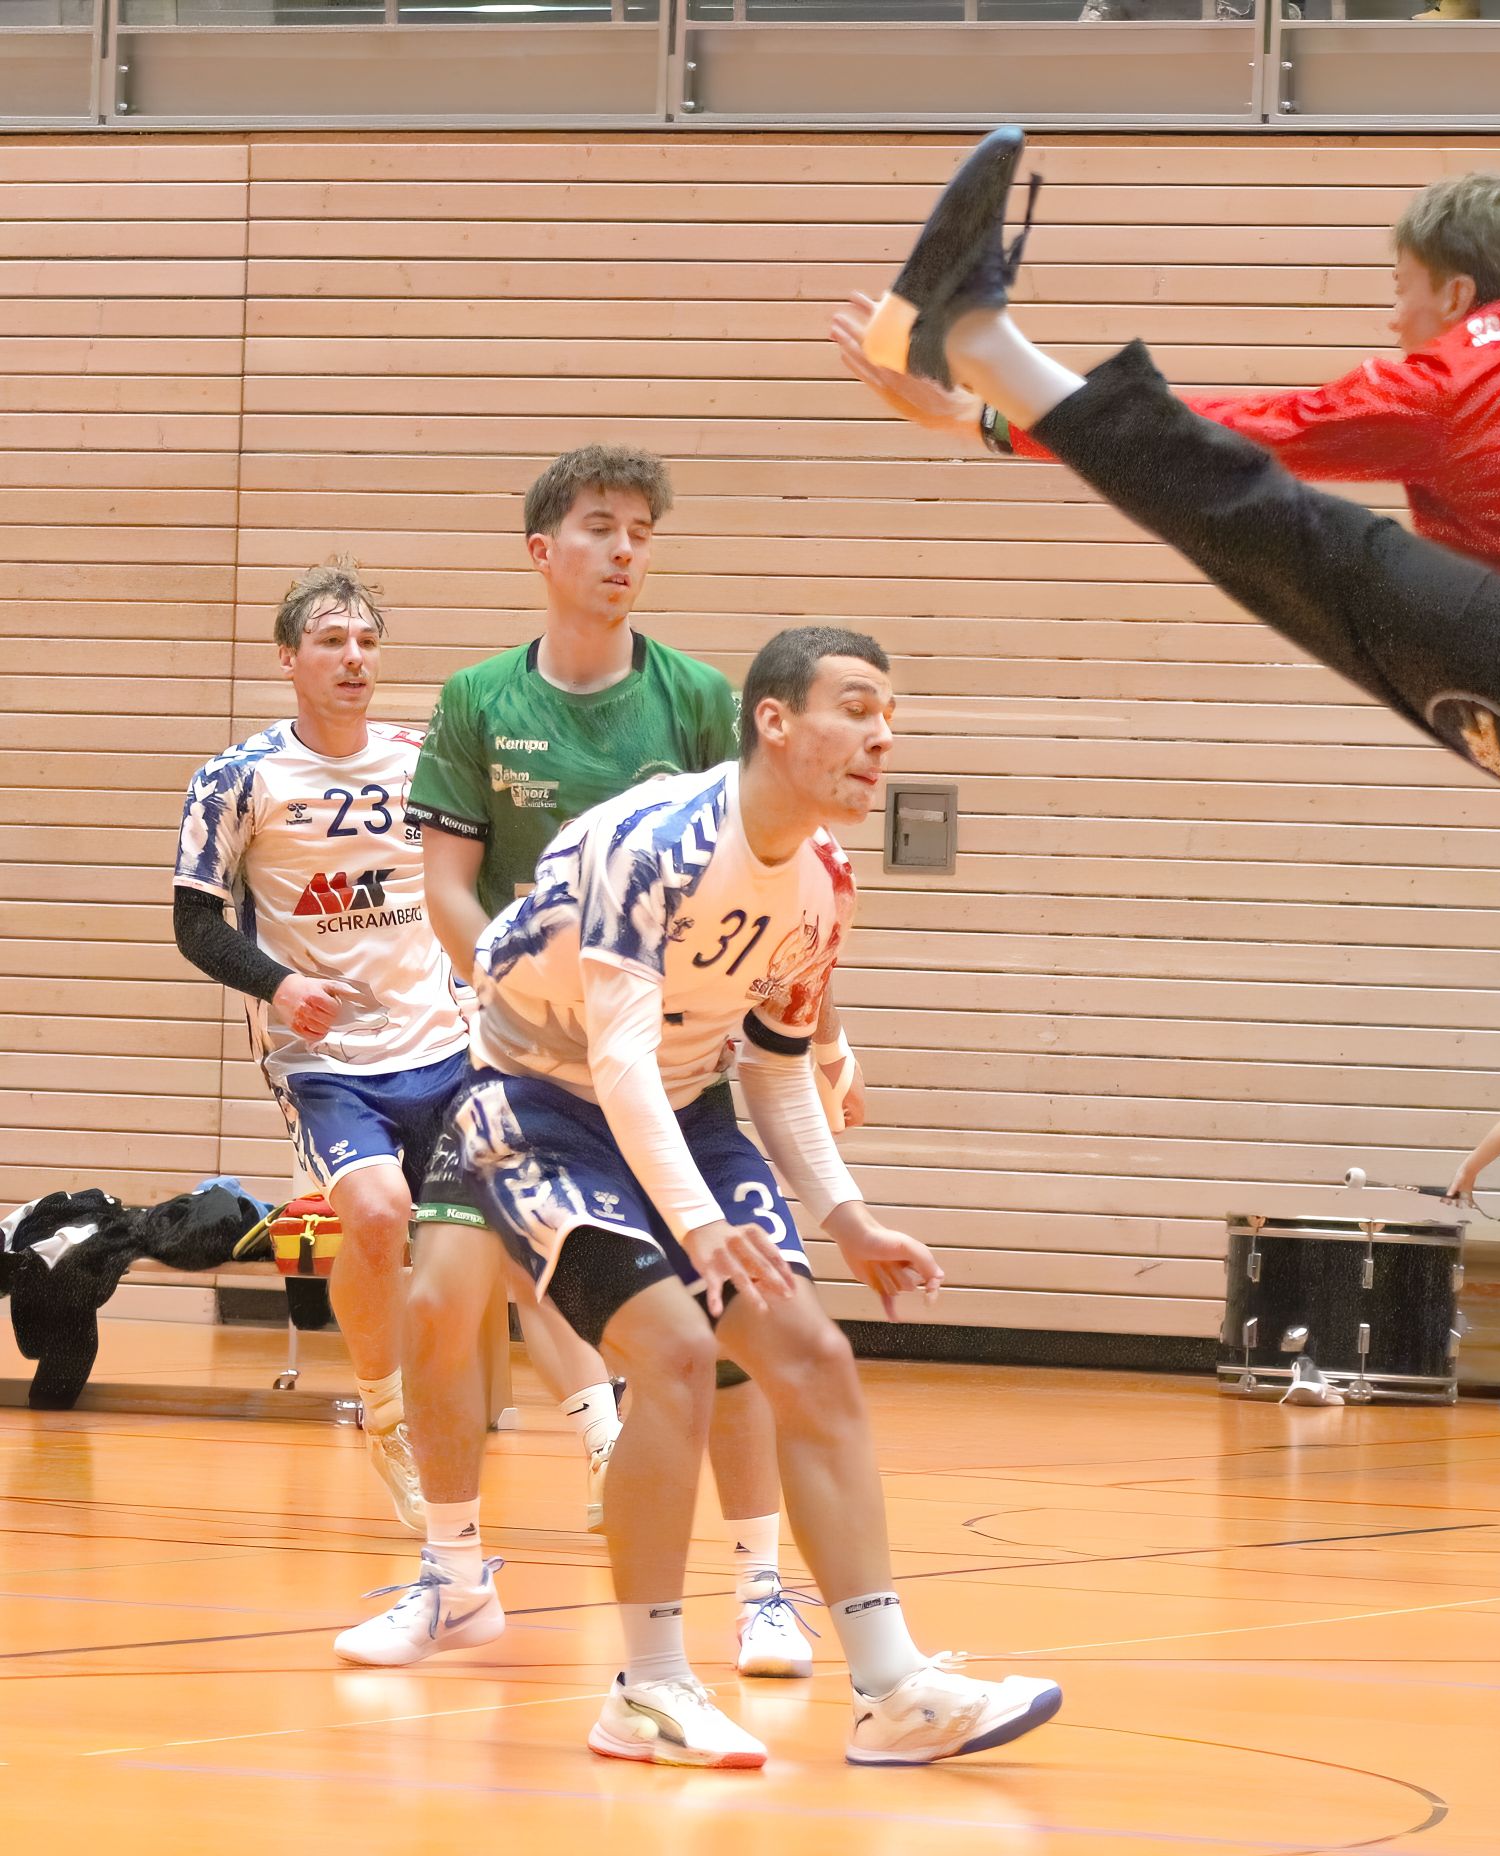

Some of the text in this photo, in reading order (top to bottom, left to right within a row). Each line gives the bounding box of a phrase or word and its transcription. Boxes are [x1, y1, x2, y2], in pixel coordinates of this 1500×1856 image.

[494, 735, 549, 754] Kempa
[324, 784, 392, 838] 23
[316, 906, 422, 934] SCHRAMBERG
[692, 909, 771, 976] 31
[733, 1181, 787, 1244] 3
